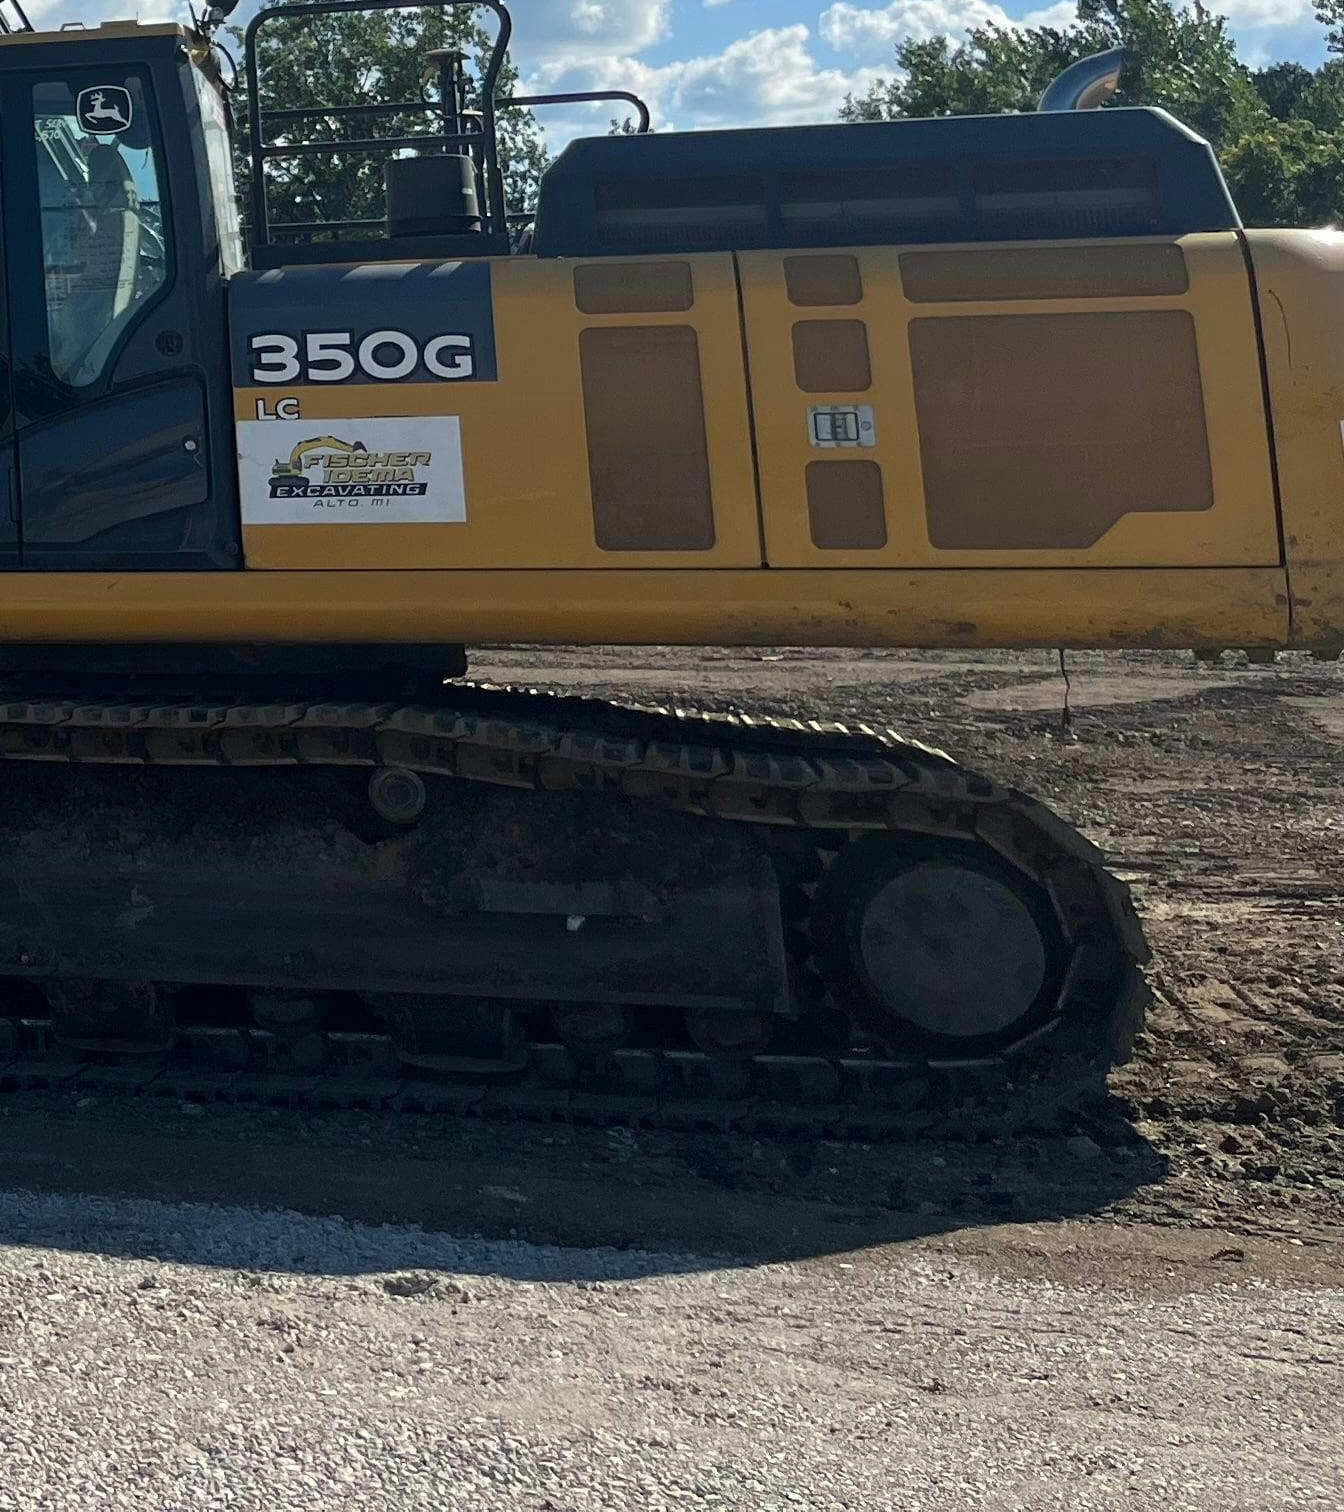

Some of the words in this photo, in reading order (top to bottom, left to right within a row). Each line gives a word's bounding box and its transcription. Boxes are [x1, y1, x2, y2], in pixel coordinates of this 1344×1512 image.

[251, 330, 473, 383] 350G
[256, 398, 299, 420] LC
[304, 451, 432, 469] FISCHER
[323, 468, 415, 483] IDEMA
[276, 484, 421, 497] EXCAVATING
[371, 498, 390, 507] MI
